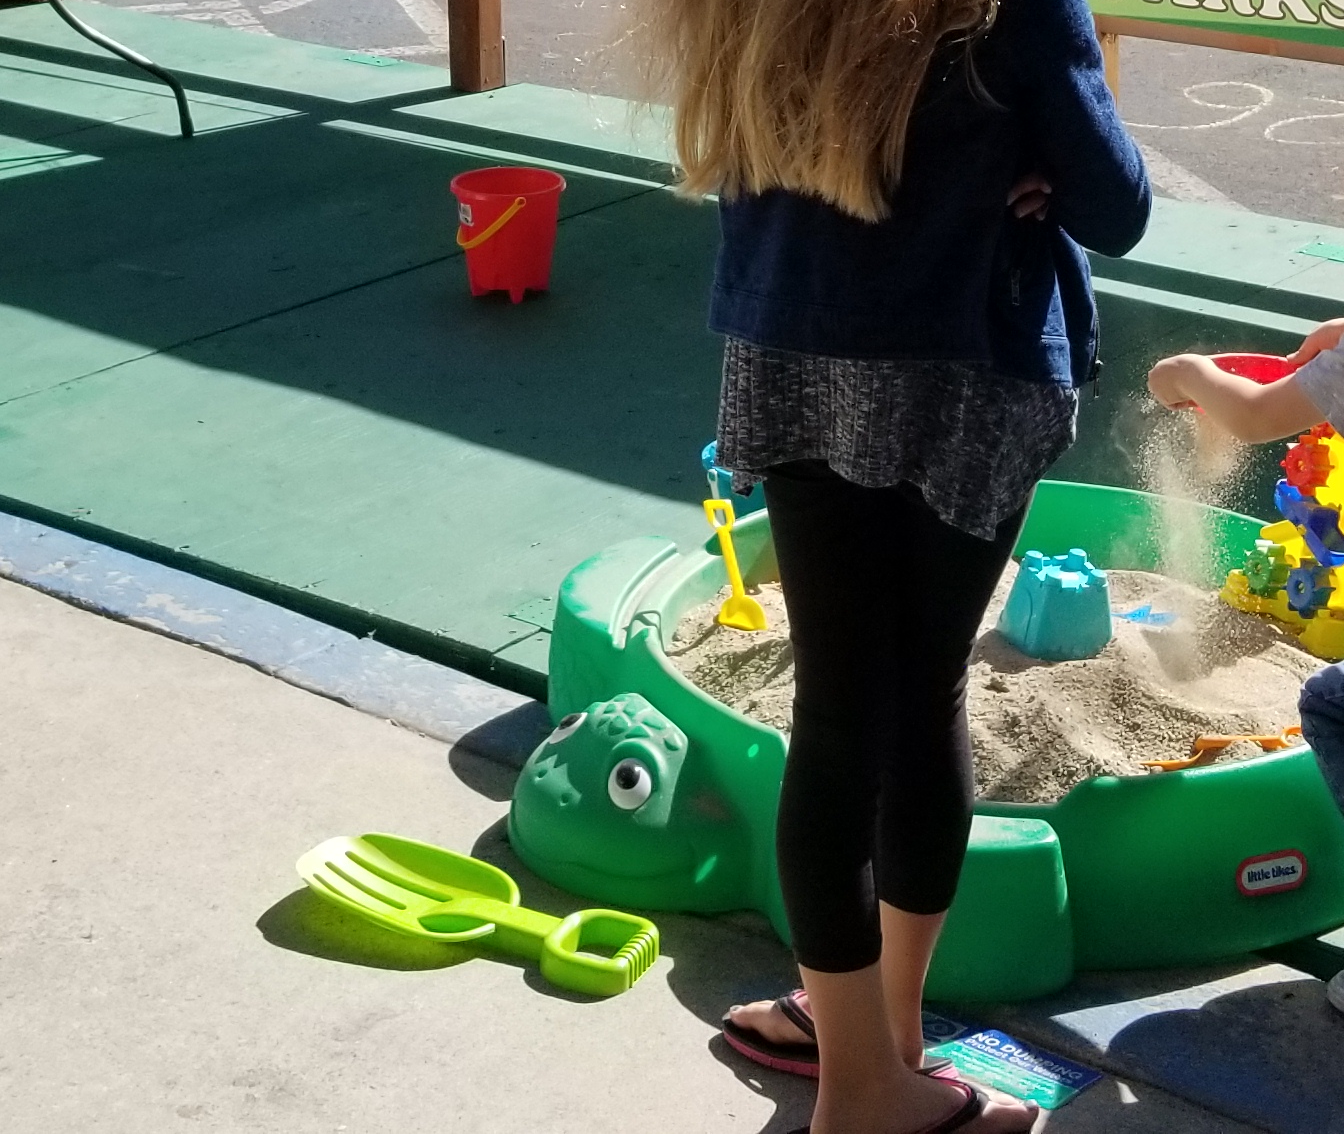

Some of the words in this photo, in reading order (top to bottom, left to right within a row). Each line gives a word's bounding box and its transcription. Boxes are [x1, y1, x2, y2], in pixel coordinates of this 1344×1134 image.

[1247, 869, 1271, 882] little
[964, 1038, 1008, 1059] Protect
[971, 1032, 1000, 1047] NO
[999, 1042, 1083, 1080] DUMPING
